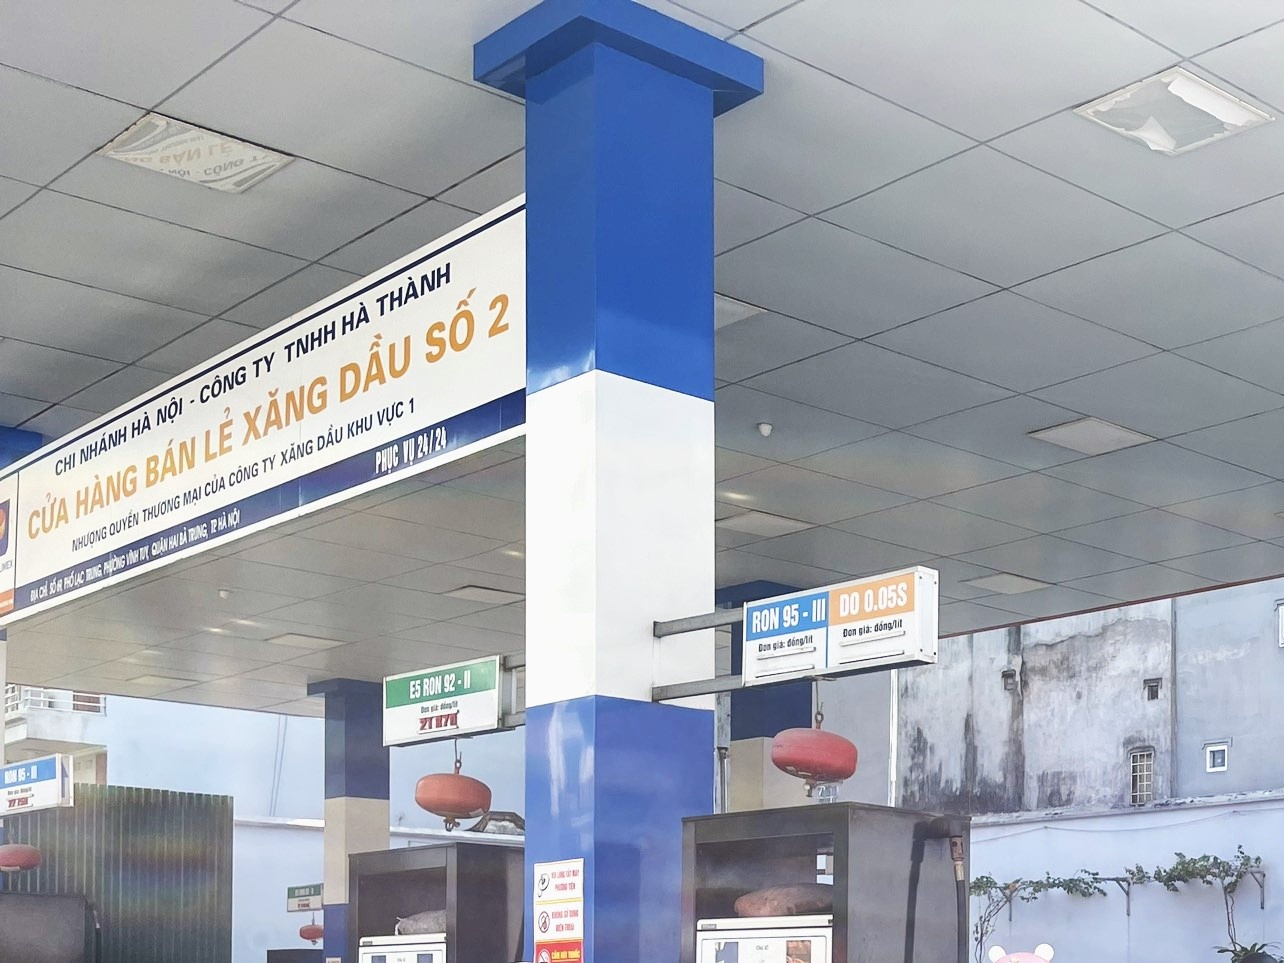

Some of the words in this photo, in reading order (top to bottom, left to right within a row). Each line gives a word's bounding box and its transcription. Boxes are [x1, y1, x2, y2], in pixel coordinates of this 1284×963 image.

[55, 452, 76, 476] CHI
[79, 426, 127, 464] NHÁNH
[131, 411, 152, 438] HÀ
[156, 397, 183, 430] NỘI
[199, 359, 247, 404] CÔNG
[252, 352, 275, 378] TY
[284, 321, 336, 362] TNHH
[341, 301, 371, 335] HÀ
[376, 262, 451, 316] THÀNH
[28, 491, 69, 540] CỬA
[75, 464, 138, 520] HÀNG
[145, 435, 197, 488] BÁN
[204, 406, 234, 463] LẺ
[242, 376, 328, 447] XĂNG
[340, 333, 411, 403] DẦU
[425, 287, 477, 364] SỐ
[488, 293, 510, 338] 2
[183, 486, 202, 508] MẠI
[204, 473, 226, 498] CỦA
[229, 461, 259, 489] CÔNG
[261, 454, 276, 474] TY
[280, 438, 314, 466] XĂNG
[317, 424, 343, 452] DẦU
[347, 414, 373, 440] KHU
[377, 401, 404, 427] VỰC
[408, 398, 415, 414] 1
[375, 444, 399, 475] PHỤC
[402, 439, 415, 466] VỤ
[752, 606, 780, 633] RON
[782, 603, 800, 629] 95
[811, 597, 826, 623] III
[839, 590, 861, 618] DO
[863, 582, 908, 614] 0.05S
[409, 680, 421, 699] E5
[423, 674, 442, 697] RON
[443, 672, 456, 693] 92
[463, 669, 471, 690] II
